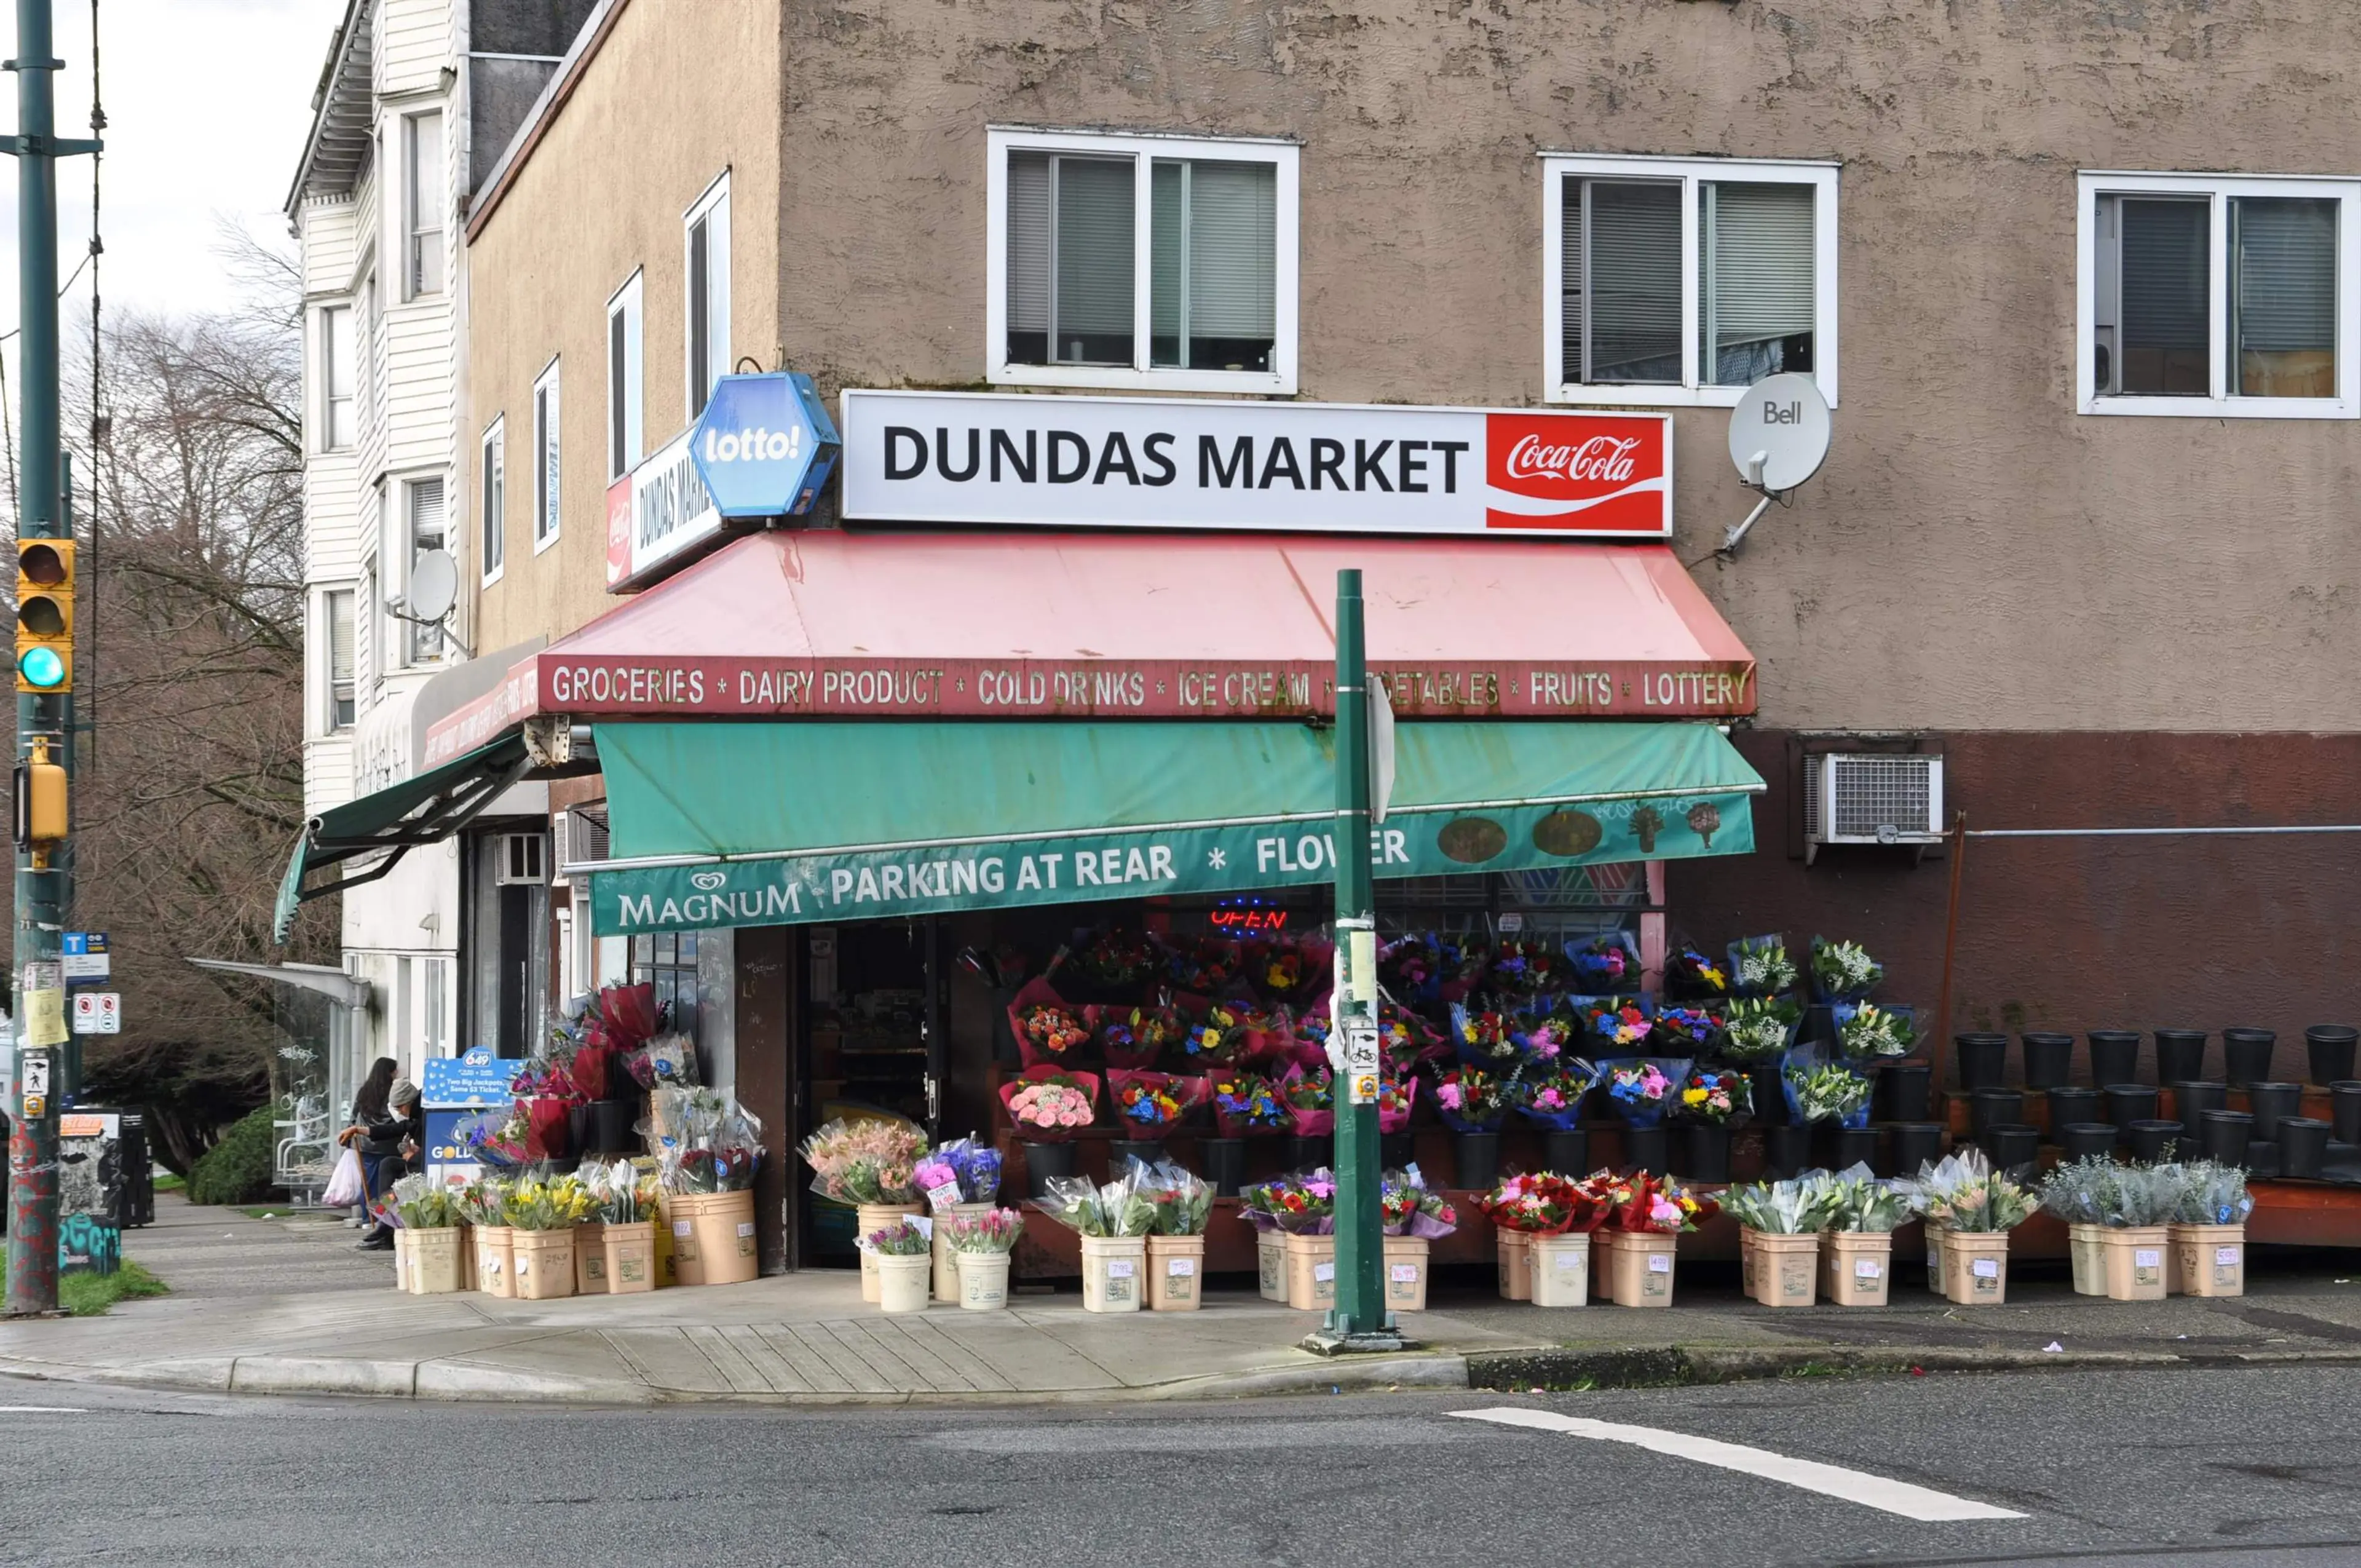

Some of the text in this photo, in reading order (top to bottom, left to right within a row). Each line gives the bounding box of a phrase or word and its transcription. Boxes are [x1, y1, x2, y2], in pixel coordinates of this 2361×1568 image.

[1763, 401, 1801, 425] Bell
[705, 425, 800, 463] lotto!
[883, 426, 1469, 494] DUNDAS MARKET
[1506, 434, 1642, 481] Coca-Cola
[639, 466, 675, 550] DUNDAS
[553, 666, 704, 705] GROCERIES
[740, 670, 814, 705] DAIRY
[823, 670, 943, 705] PRODUCT
[978, 670, 1045, 707] COLD
[1054, 671, 1144, 707] DRINKS
[1178, 671, 1217, 707] ICE
[1224, 671, 1310, 707] CREAM
[1530, 671, 1612, 707] FRUITS
[1644, 671, 1747, 706] LOTTERY
[617, 882, 801, 927] MAGNUM
[831, 858, 1005, 905] PARKING
[1016, 853, 1063, 891] AT
[1075, 845, 1177, 886] REAR
